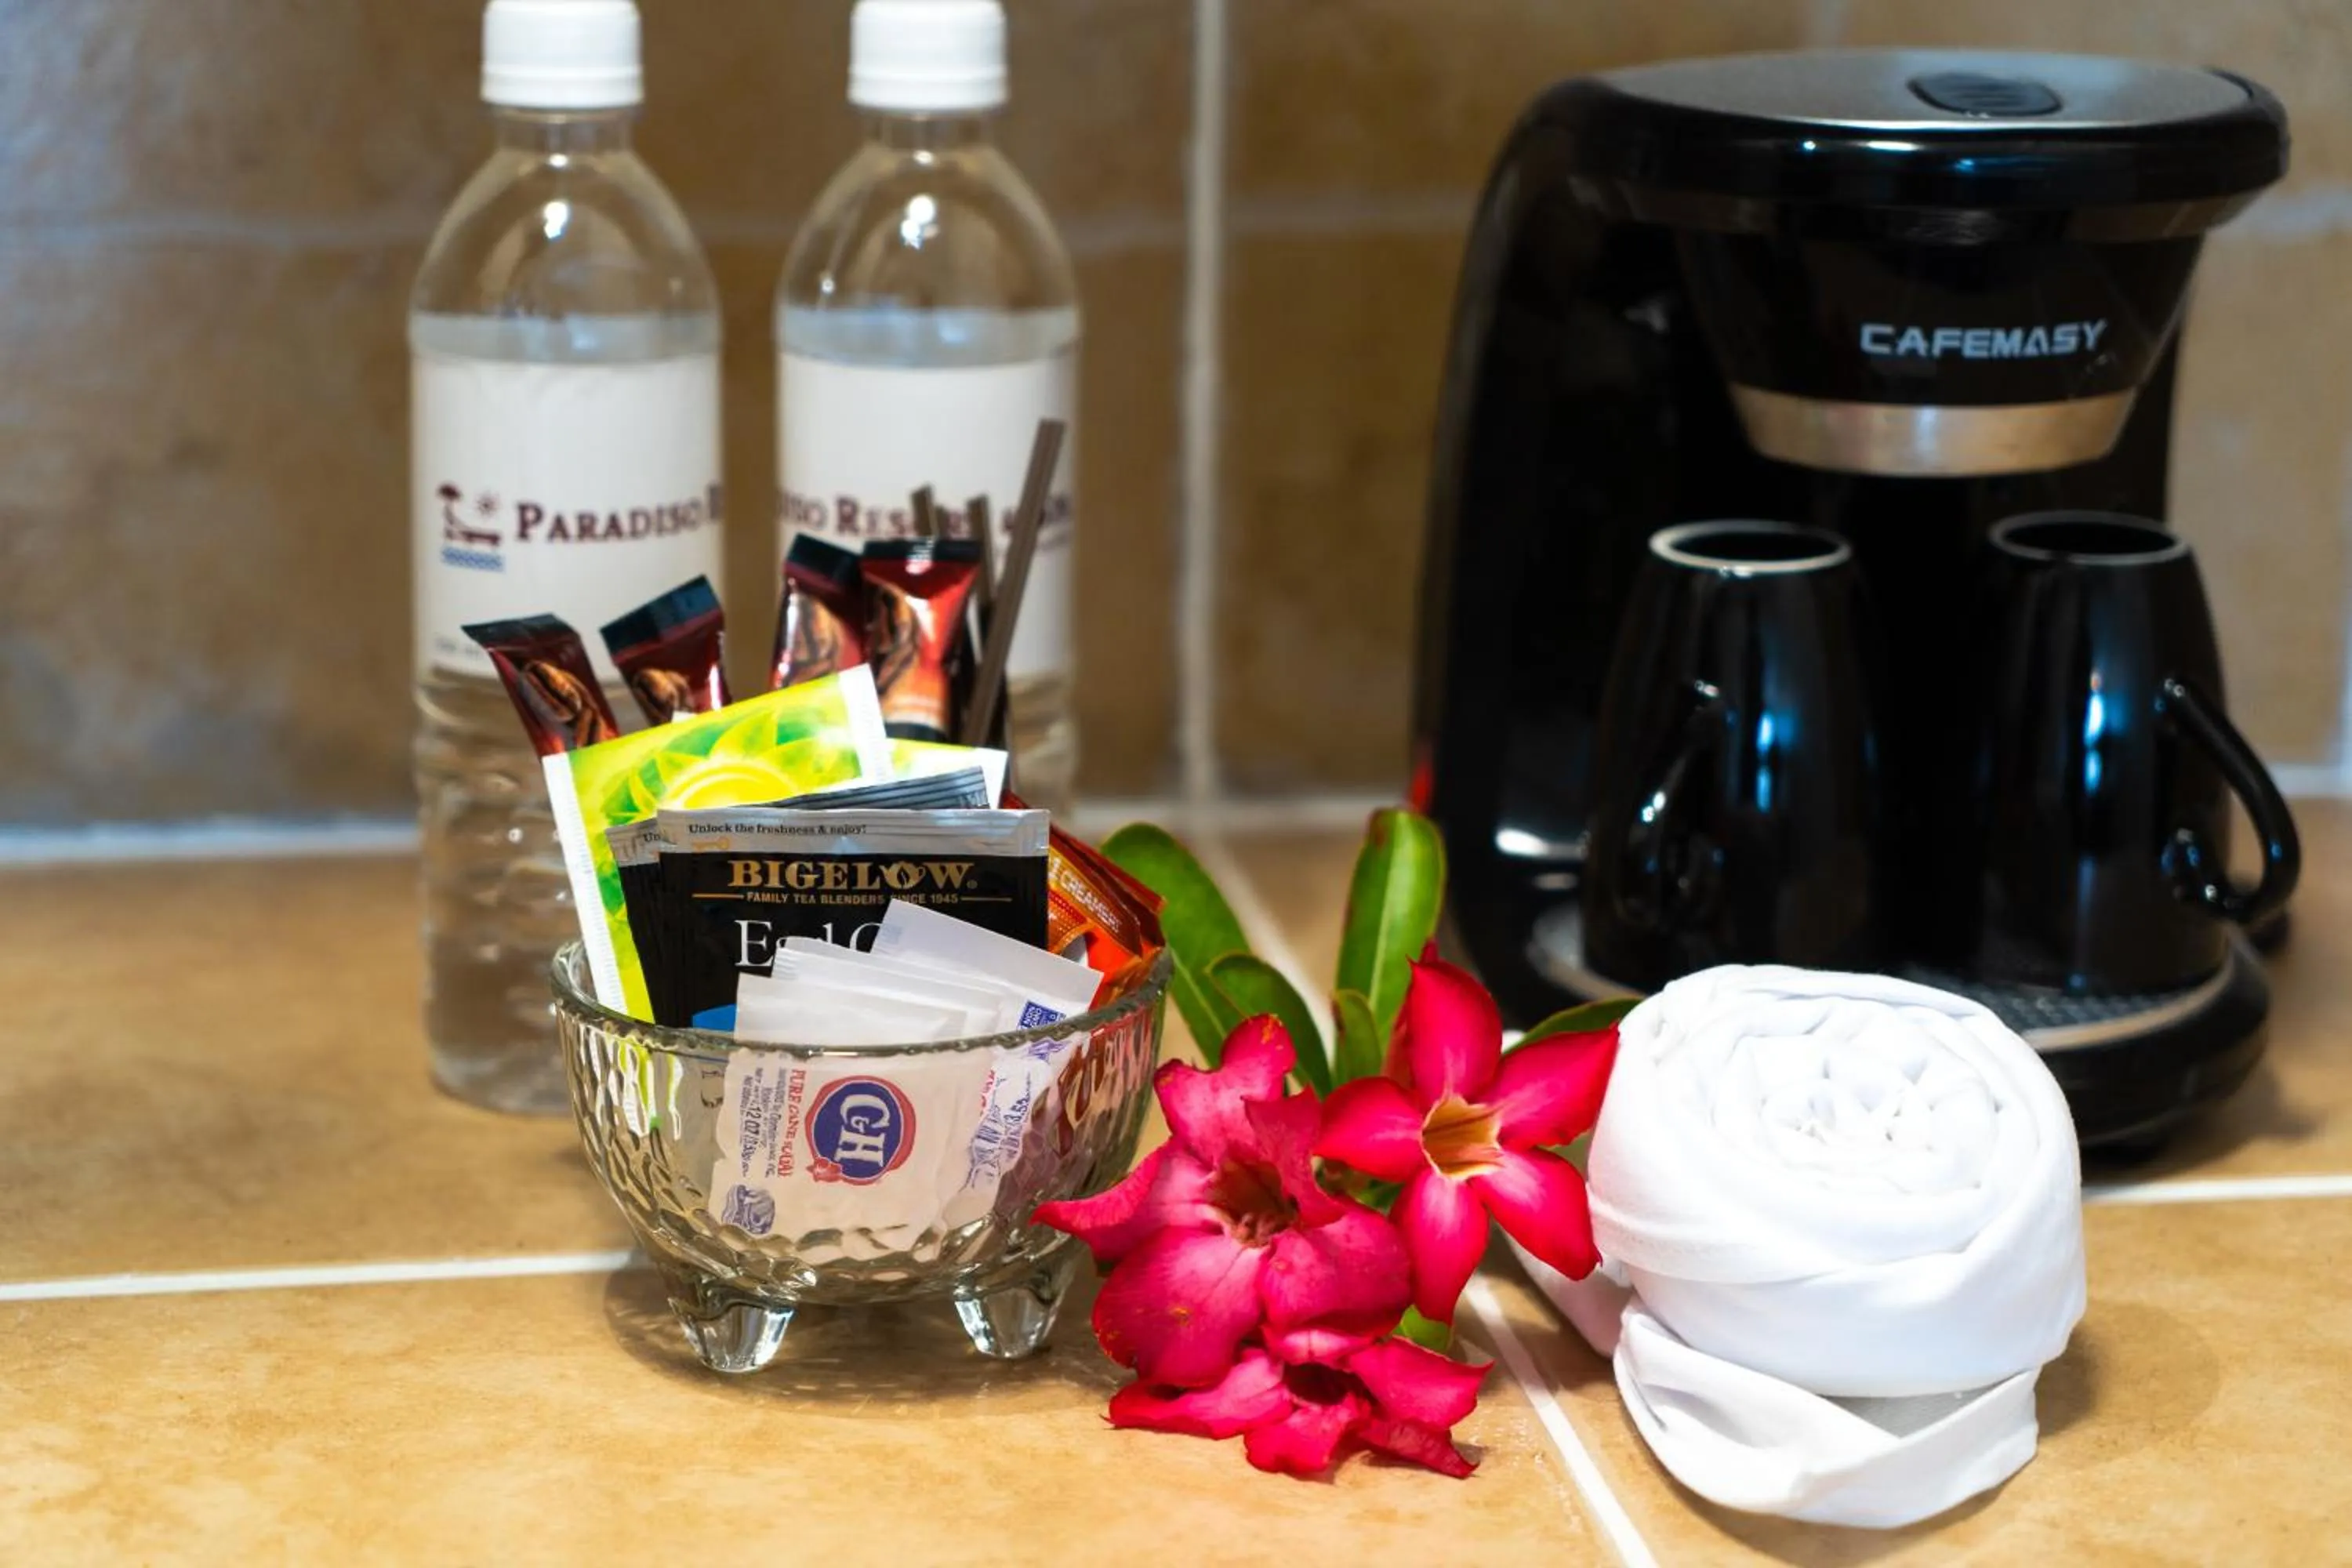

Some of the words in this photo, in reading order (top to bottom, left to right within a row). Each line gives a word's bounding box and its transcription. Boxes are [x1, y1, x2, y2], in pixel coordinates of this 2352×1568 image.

[1860, 319, 2107, 358] CAFEMASY
[516, 497, 702, 543] PARADISO
[688, 824, 732, 834] Unlock
[735, 823, 754, 833] the
[757, 823, 815, 835] freshness
[728, 859, 975, 890] BIGELOW
[746, 891, 787, 903] FAMILY
[793, 892, 815, 904] TEA
[821, 893, 884, 905] BLENDERS
[931, 892, 958, 904] 1945
[789, 1069, 807, 1102] PURE
